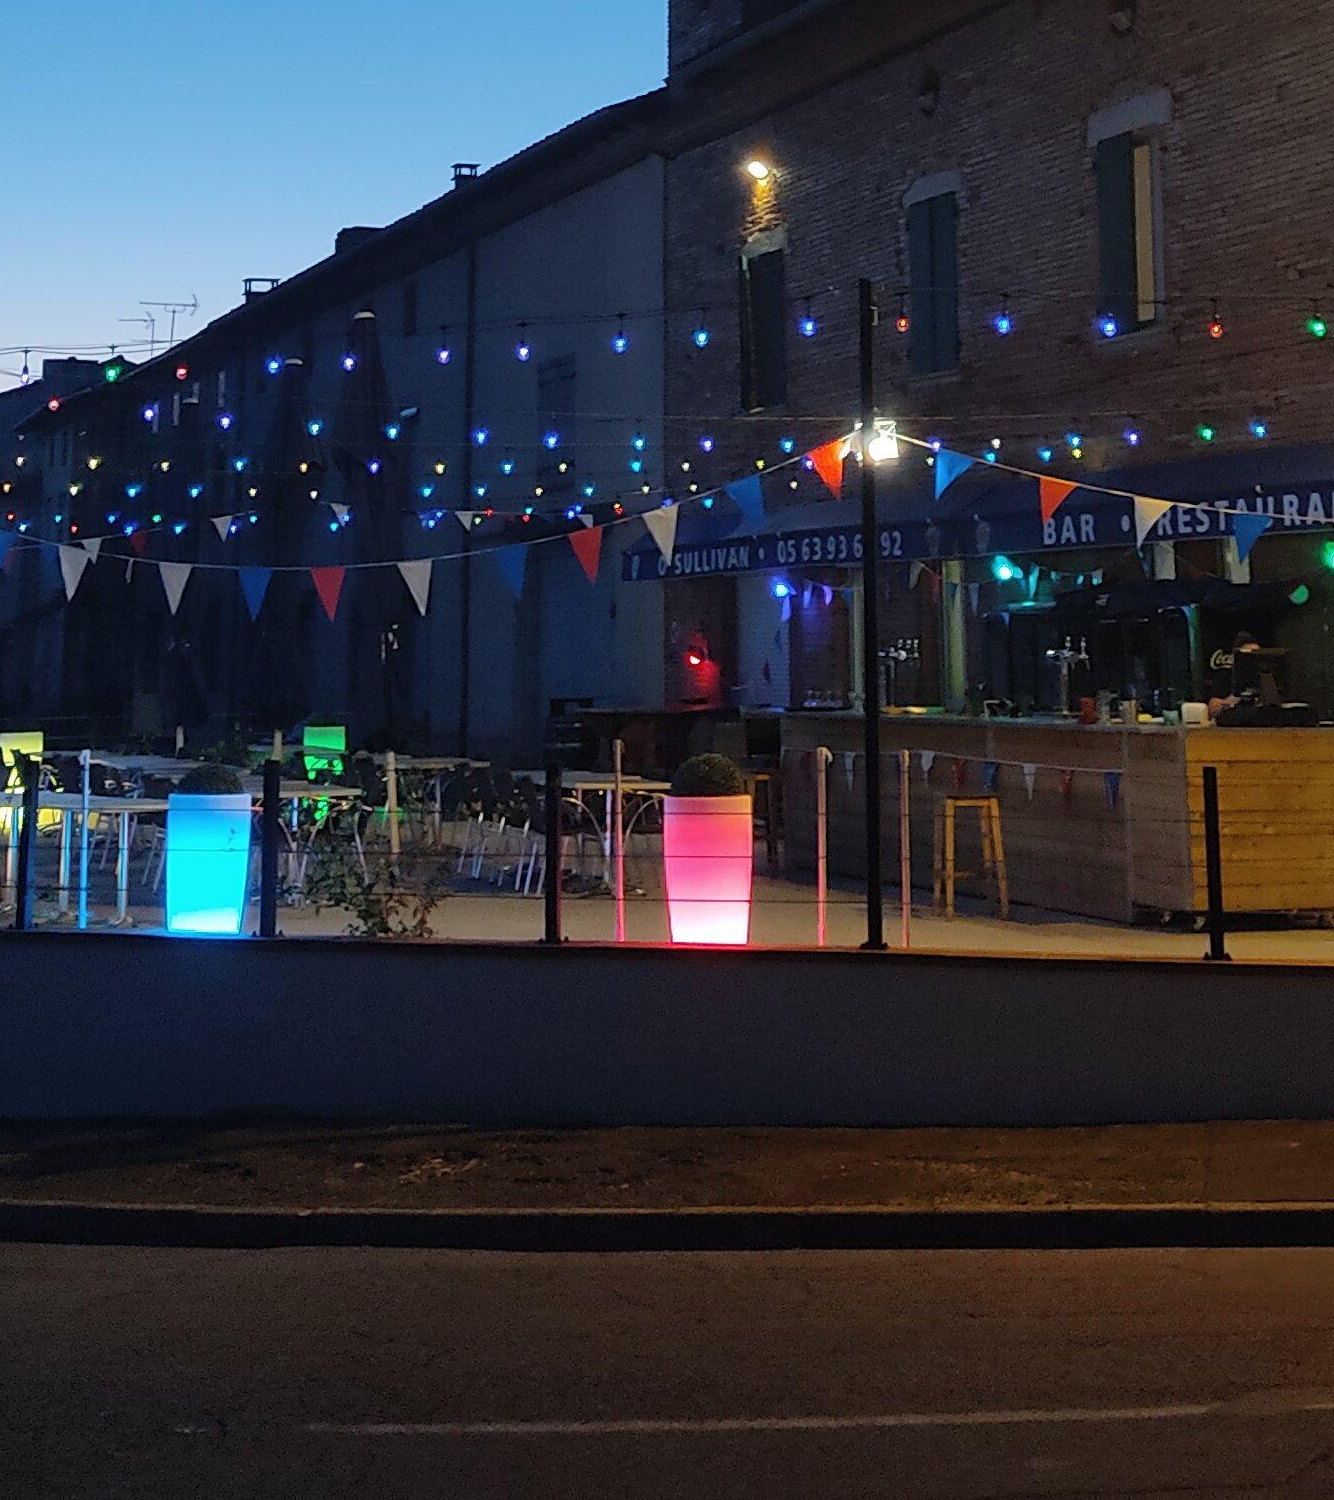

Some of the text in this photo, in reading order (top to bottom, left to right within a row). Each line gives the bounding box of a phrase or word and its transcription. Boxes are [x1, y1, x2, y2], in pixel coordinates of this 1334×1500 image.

[1043, 513, 1096, 546] BAR
[657, 546, 750, 577] OSULLIVAN
[777, 539, 797, 564] 05
[801, 537, 823, 562] 63
[827, 534, 847, 560] 93
[879, 530, 903, 557] 92
